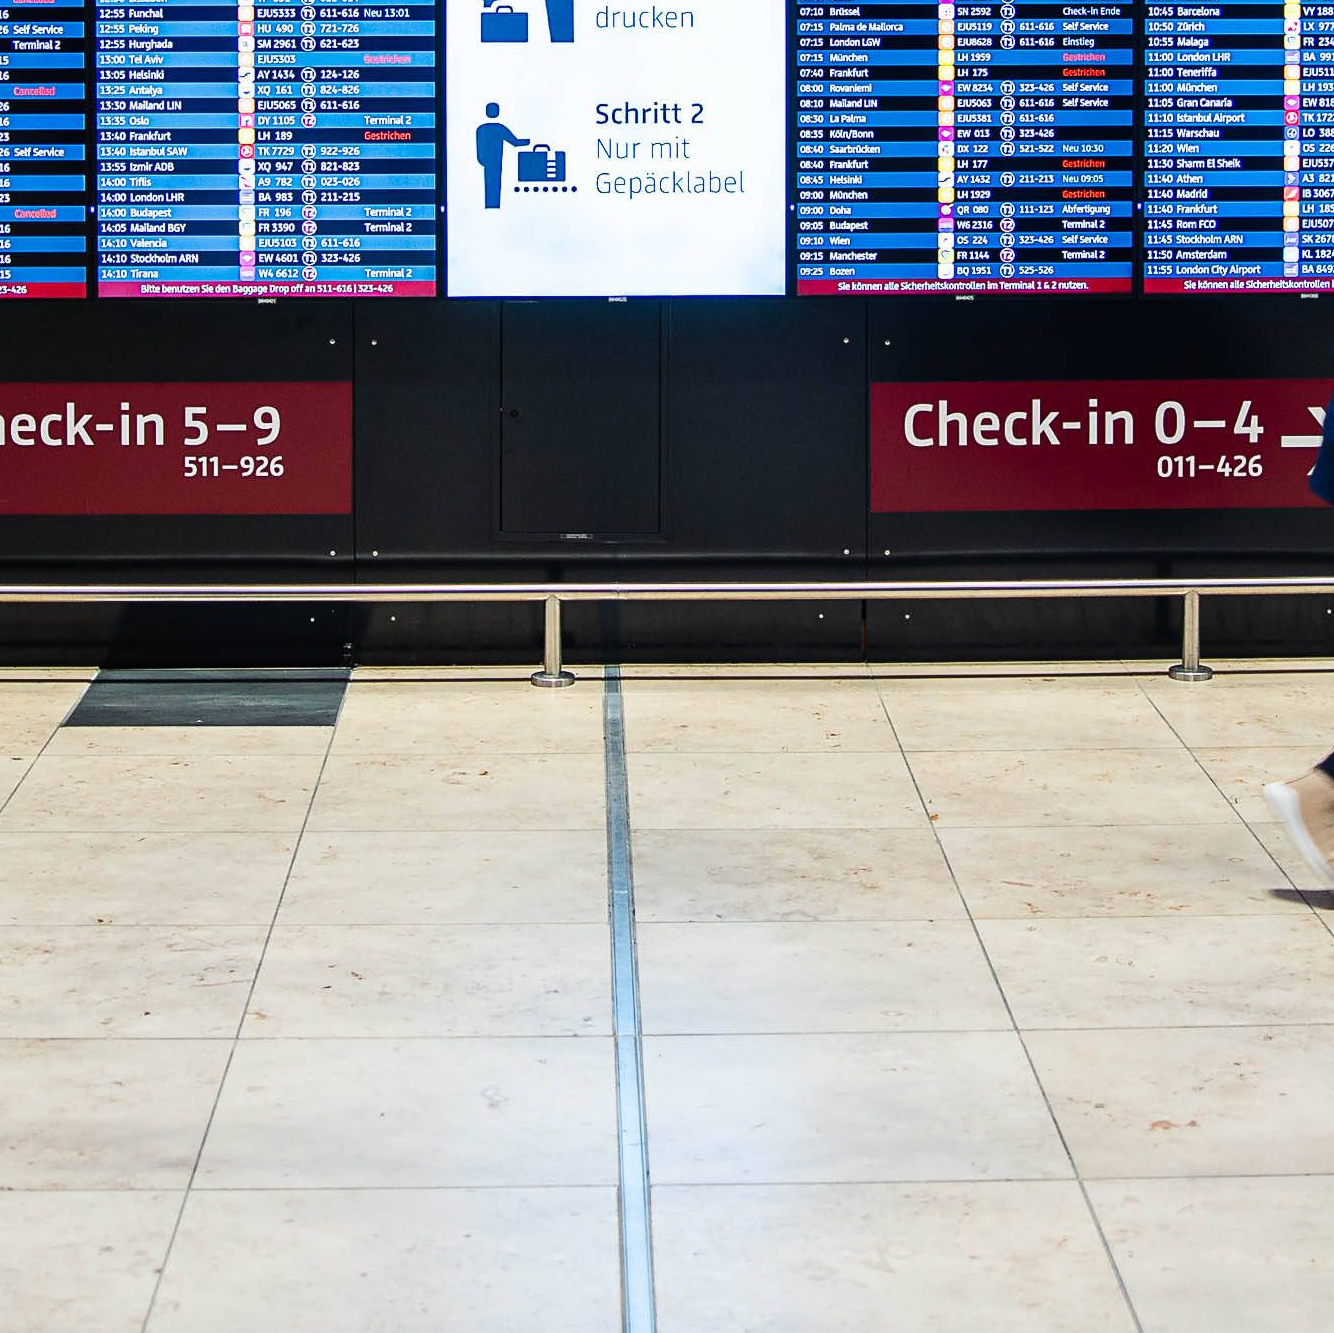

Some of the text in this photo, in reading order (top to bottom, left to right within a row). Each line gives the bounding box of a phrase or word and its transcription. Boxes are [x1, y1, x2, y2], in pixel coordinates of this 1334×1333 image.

[596, 5, 694, 28] drucken
[595, 103, 704, 124] Schritt 2
[101, 131, 411, 140] 13:40 Frankfurt LH 189 Gestrichen
[597, 138, 690, 159] Nur mit
[596, 171, 745, 199] Gepäcklabel
[904, 399, 1133, 447] Check-in
